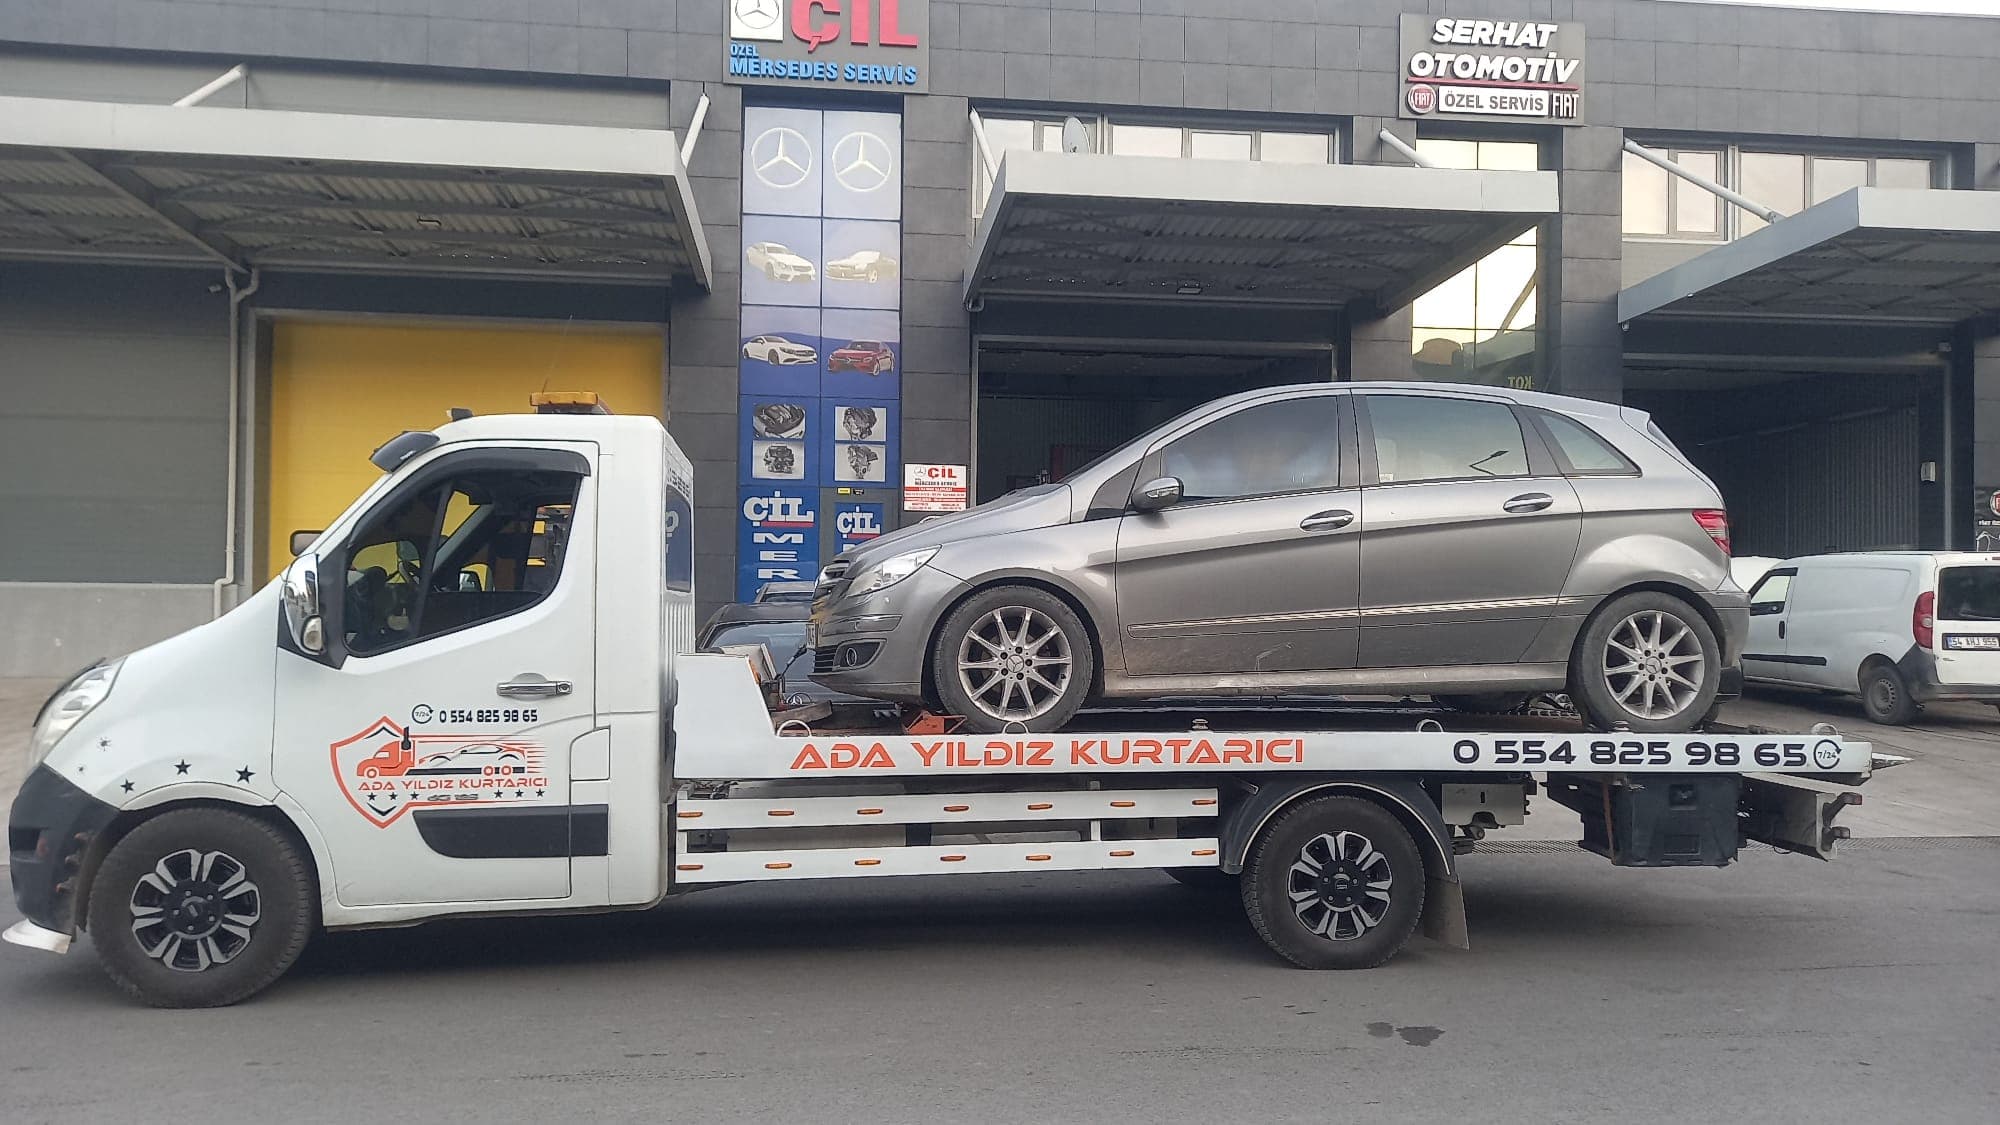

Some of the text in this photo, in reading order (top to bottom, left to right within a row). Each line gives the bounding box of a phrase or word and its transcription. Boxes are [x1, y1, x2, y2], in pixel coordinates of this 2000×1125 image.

[1432, 18, 1558, 47] SERHAT
[730, 41, 759, 58] ÖZEL
[729, 57, 918, 84] MERSEDES SERVİS
[1410, 51, 1580, 83] OTOMOTİV
[1414, 92, 1432, 106] FIAT
[1444, 89, 1544, 111] ÖZEL SERVİS
[1552, 92, 1580, 118] FIAT
[927, 465, 957, 479] ÇİL
[743, 490, 815, 527] ÇİL
[836, 505, 881, 538] ÇİL
[439, 708, 538, 723] 0 554 825 98 65
[790, 739, 1303, 769] ADA YILDIZ KURTARICI
[1453, 739, 1807, 766] 0 554 825 98 65
[358, 777, 548, 791] ADA YILDIZ KURTARICI
